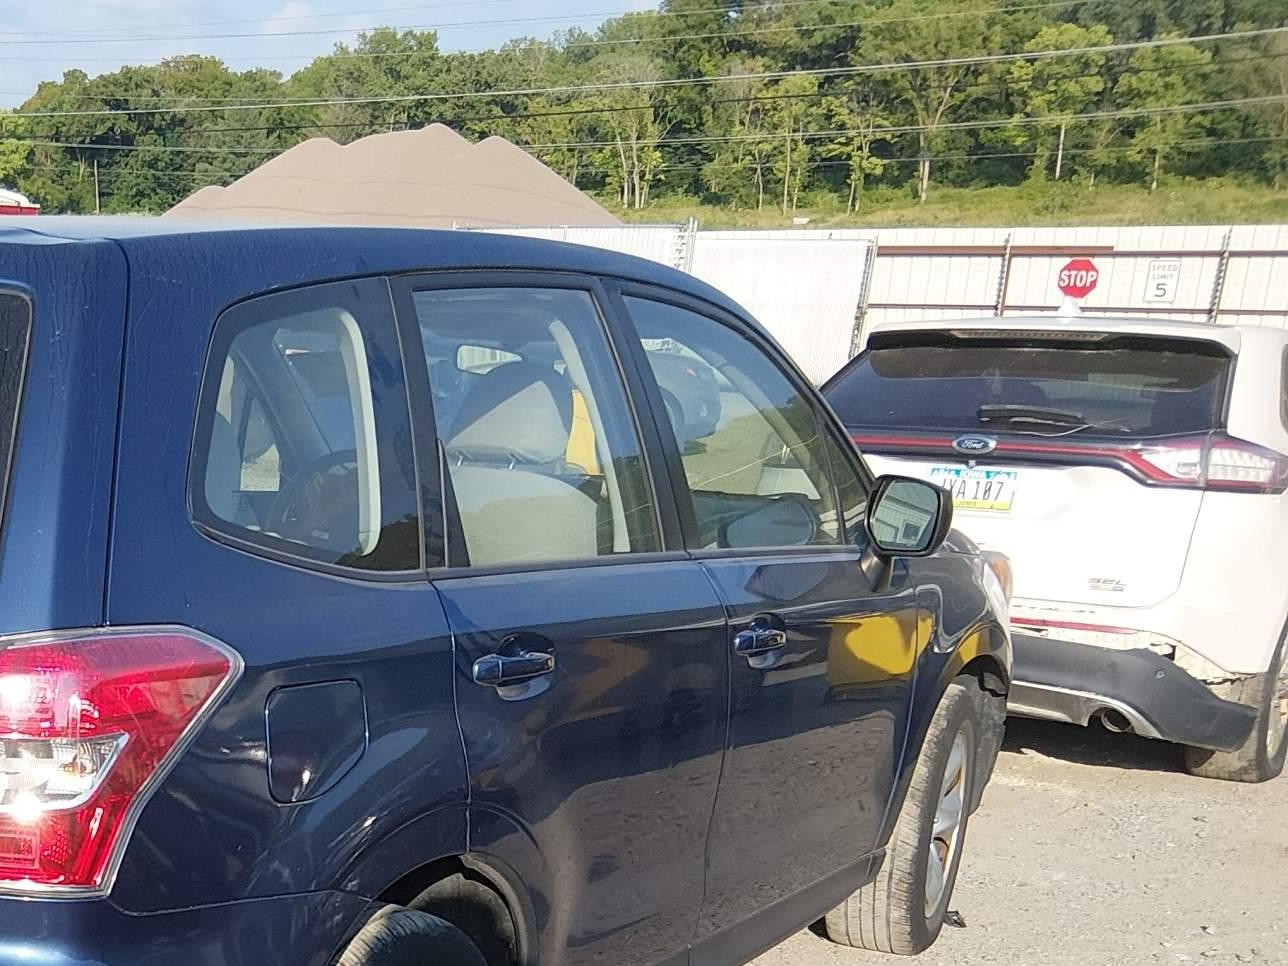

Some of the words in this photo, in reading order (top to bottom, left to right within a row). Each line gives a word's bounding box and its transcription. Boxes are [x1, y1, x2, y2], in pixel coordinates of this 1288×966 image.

[1152, 264, 1178, 272] SPEED
[1059, 269, 1098, 288] STOP
[1154, 282, 1168, 298] 5
[961, 439, 985, 449] Ford
